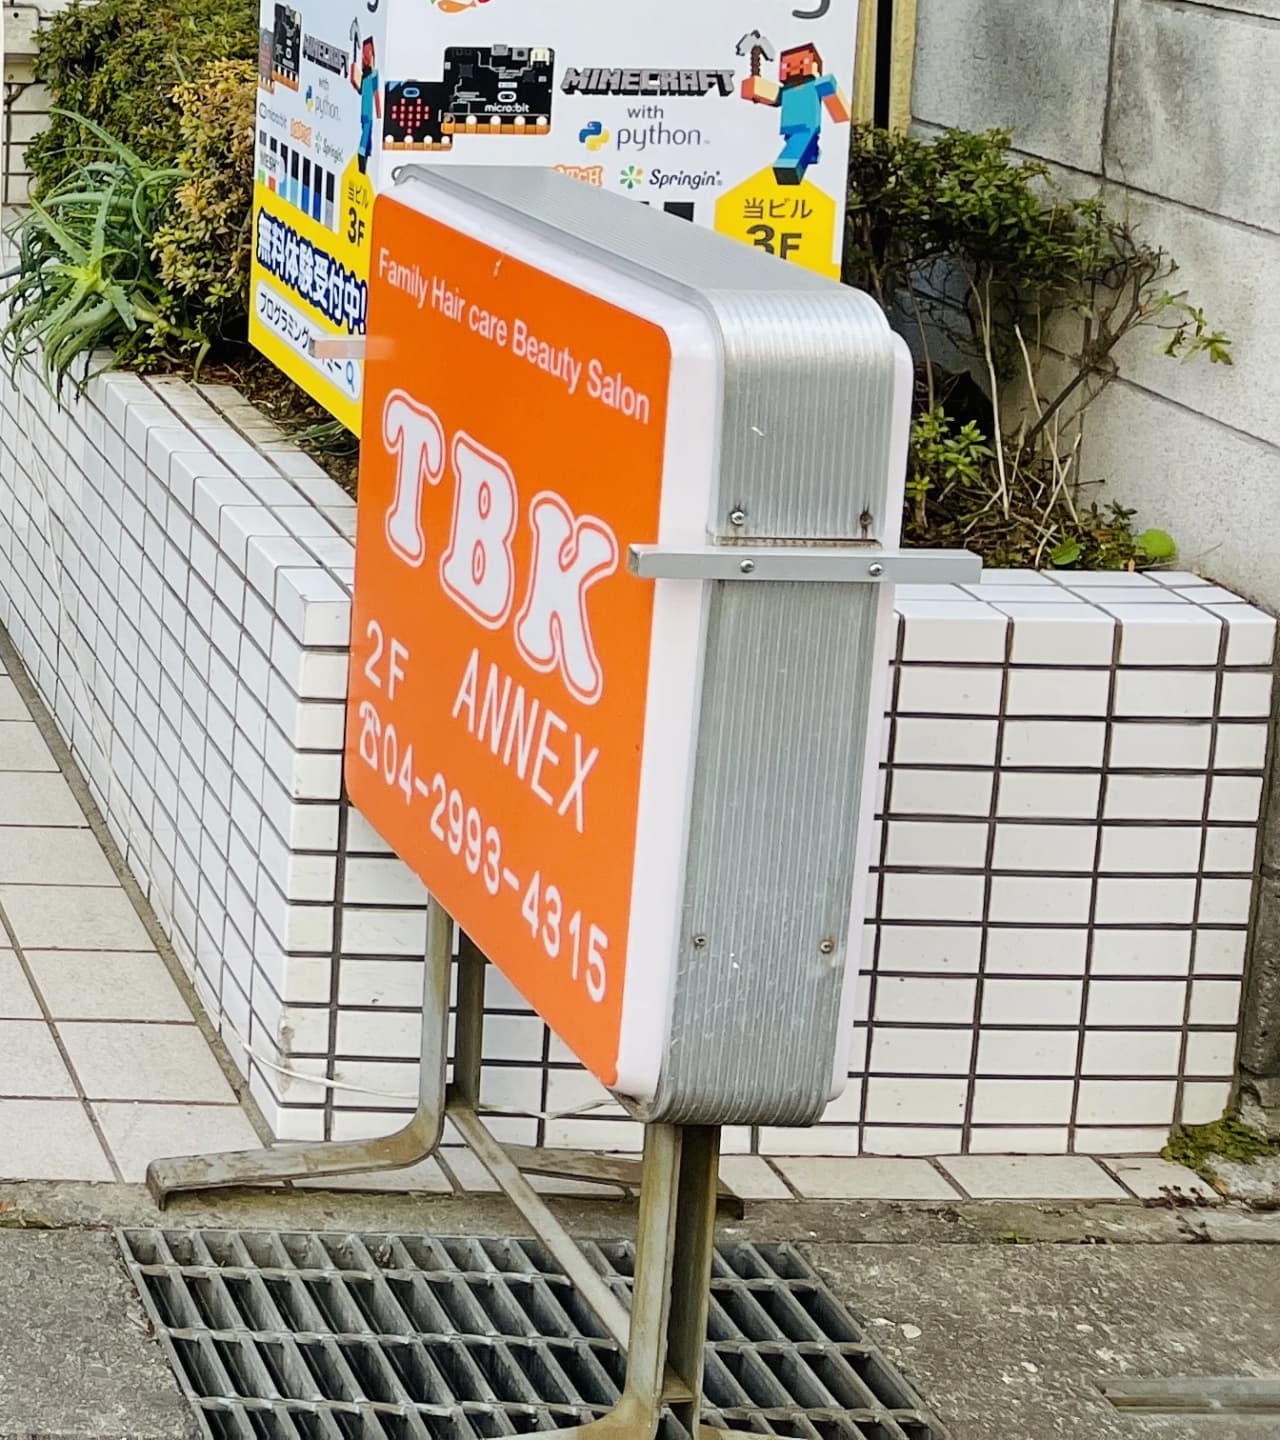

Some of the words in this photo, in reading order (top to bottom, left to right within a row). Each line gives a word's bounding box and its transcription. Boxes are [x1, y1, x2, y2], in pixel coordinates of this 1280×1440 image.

[560, 67, 736, 96] MINECRAFT
[484, 102, 530, 113] micro:bit
[627, 105, 664, 119] with
[617, 123, 702, 151] python
[347, 207, 366, 246] 3F
[743, 197, 814, 220] 当ビル
[746, 224, 802, 259] 3F
[258, 216, 368, 335] 無料体験受付中!
[260, 292, 309, 350] プログラミング
[379, 246, 428, 310] Family
[430, 281, 466, 323] Hair
[468, 306, 508, 348] care
[512, 318, 582, 397] Beauty
[586, 361, 651, 426] Salon
[382, 388, 618, 706] TBK
[364, 619, 409, 702] 2F
[451, 647, 600, 834] ANNEX
